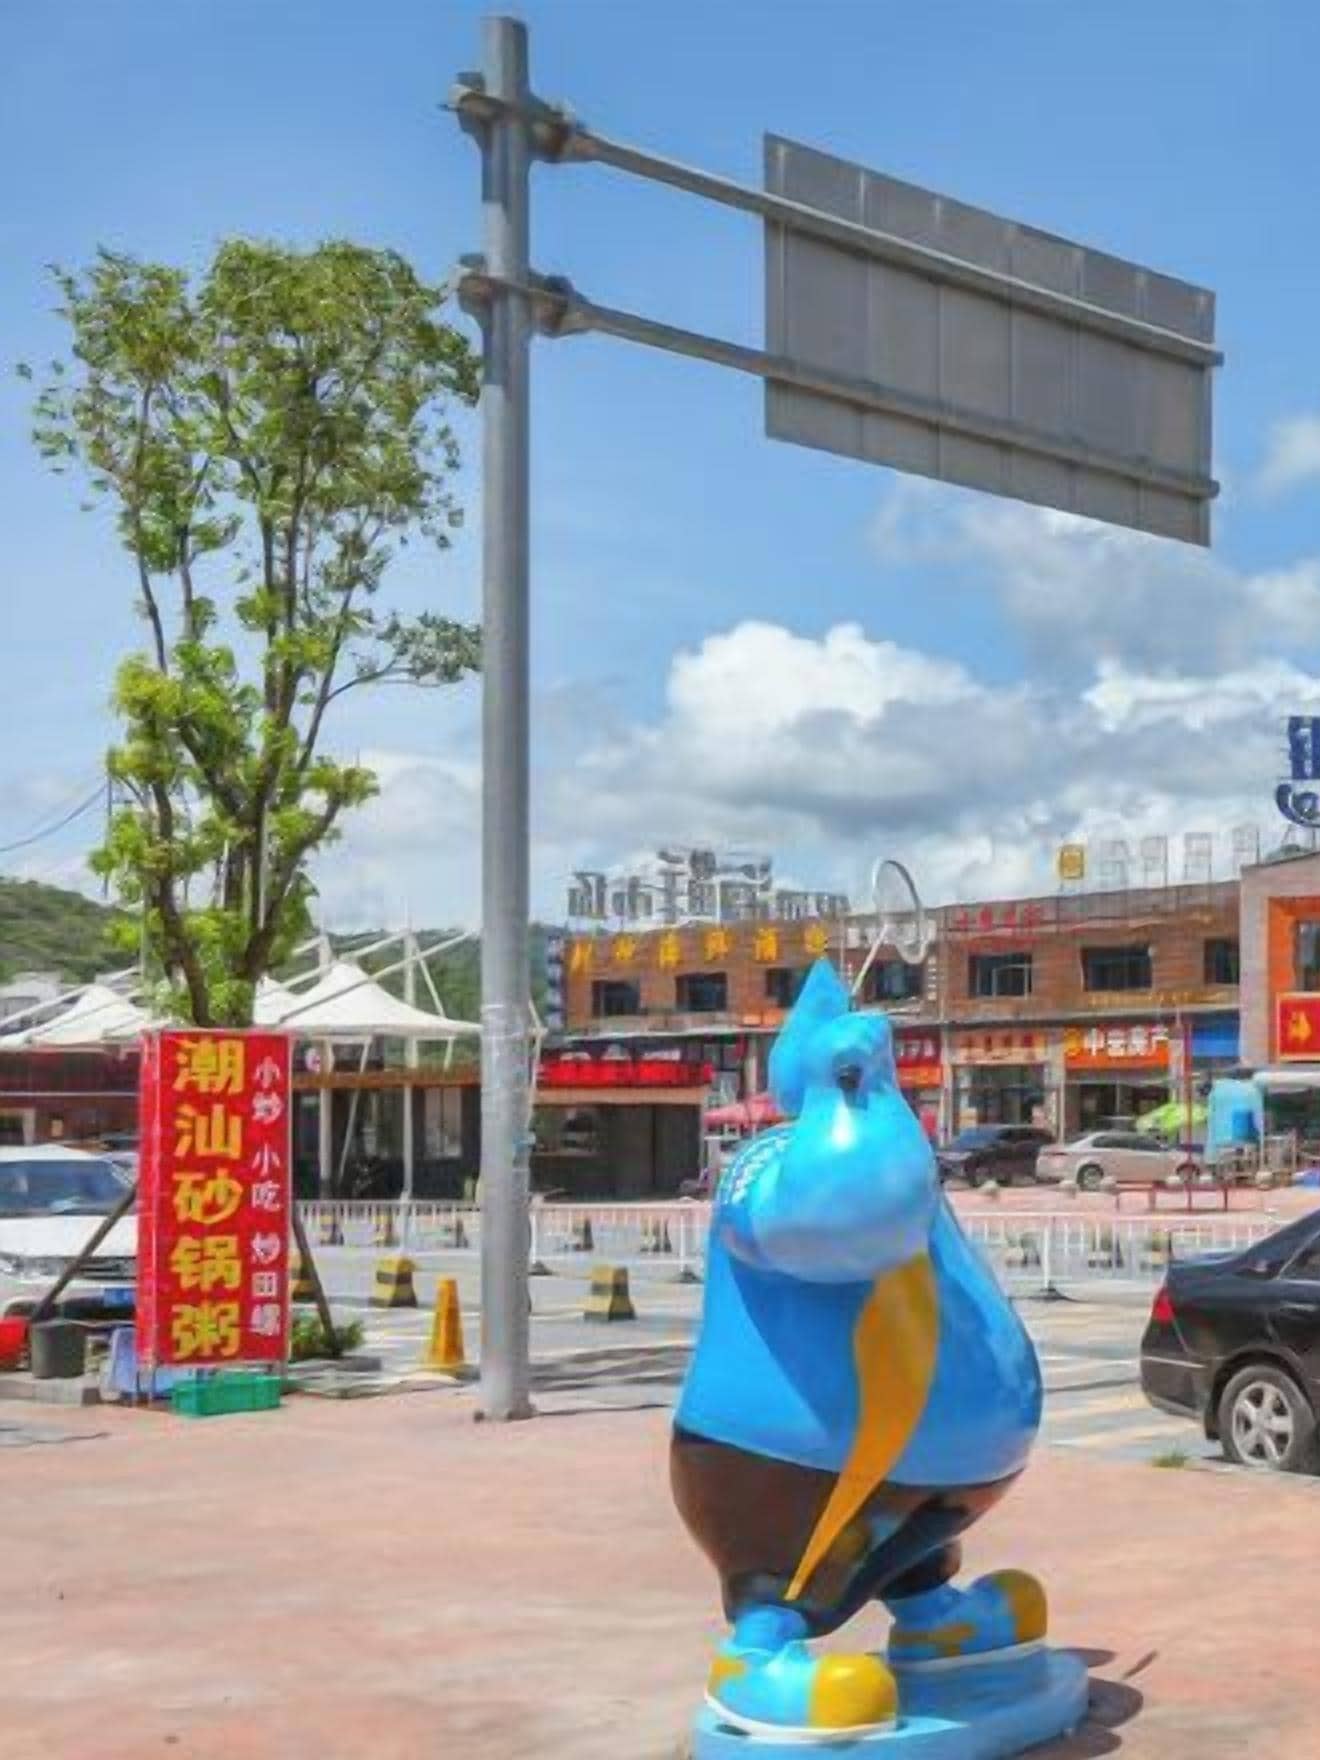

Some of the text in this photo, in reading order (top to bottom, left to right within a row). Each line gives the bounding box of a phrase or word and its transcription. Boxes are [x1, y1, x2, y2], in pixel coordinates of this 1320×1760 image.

[251, 1055, 283, 1124] 小炒
[170, 1038, 246, 1361] 潮汕砂锅粥
[251, 1143, 282, 1212] 小吃
